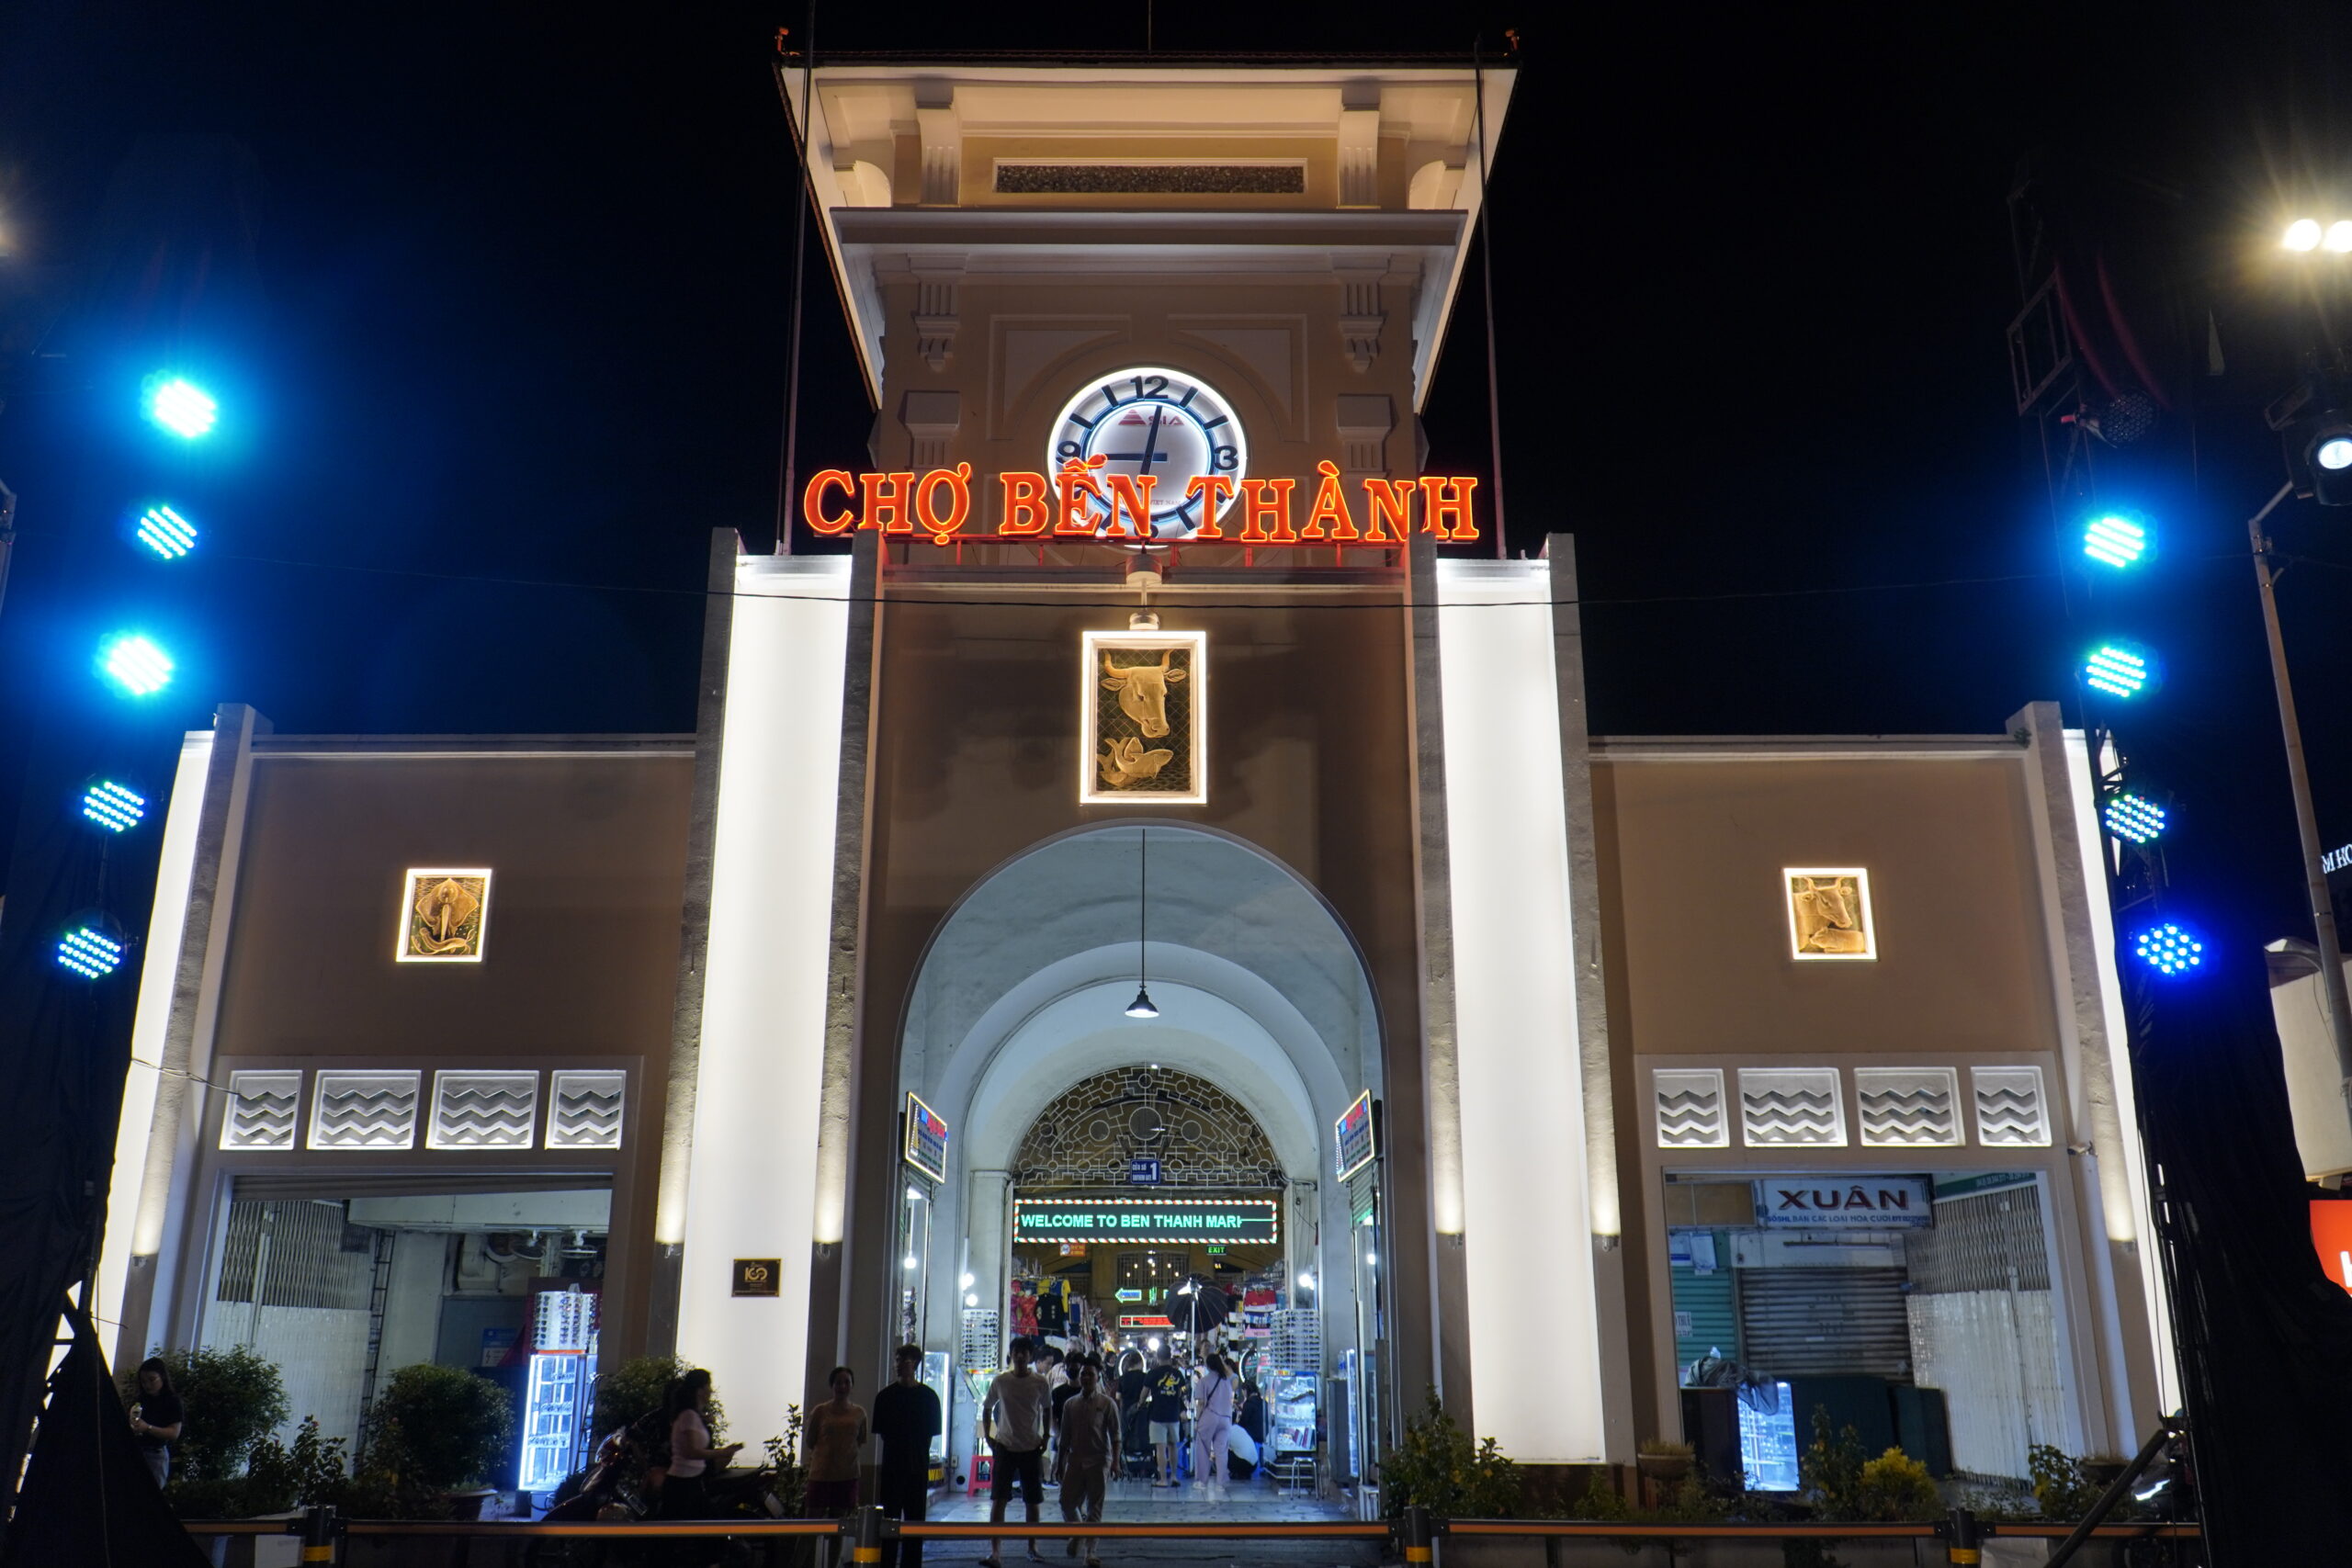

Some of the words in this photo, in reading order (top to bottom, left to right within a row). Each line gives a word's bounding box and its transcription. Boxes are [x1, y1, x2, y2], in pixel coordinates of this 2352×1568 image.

[1130, 375, 1169, 400] 12
[1057, 440, 1081, 465] 9
[1214, 445, 1238, 470] 3
[803, 461, 972, 546] CHỢ
[999, 454, 1158, 537] BẾN
[1185, 460, 1480, 542] THÀNH
[1150, 1162, 1158, 1181] 1
[1777, 1185, 1909, 1211] XUÂN
[1021, 1214, 1093, 1228] WELCOME
[1097, 1214, 1118, 1228] TO
[1121, 1214, 1149, 1228] BEN
[1154, 1214, 1203, 1228] THANH
